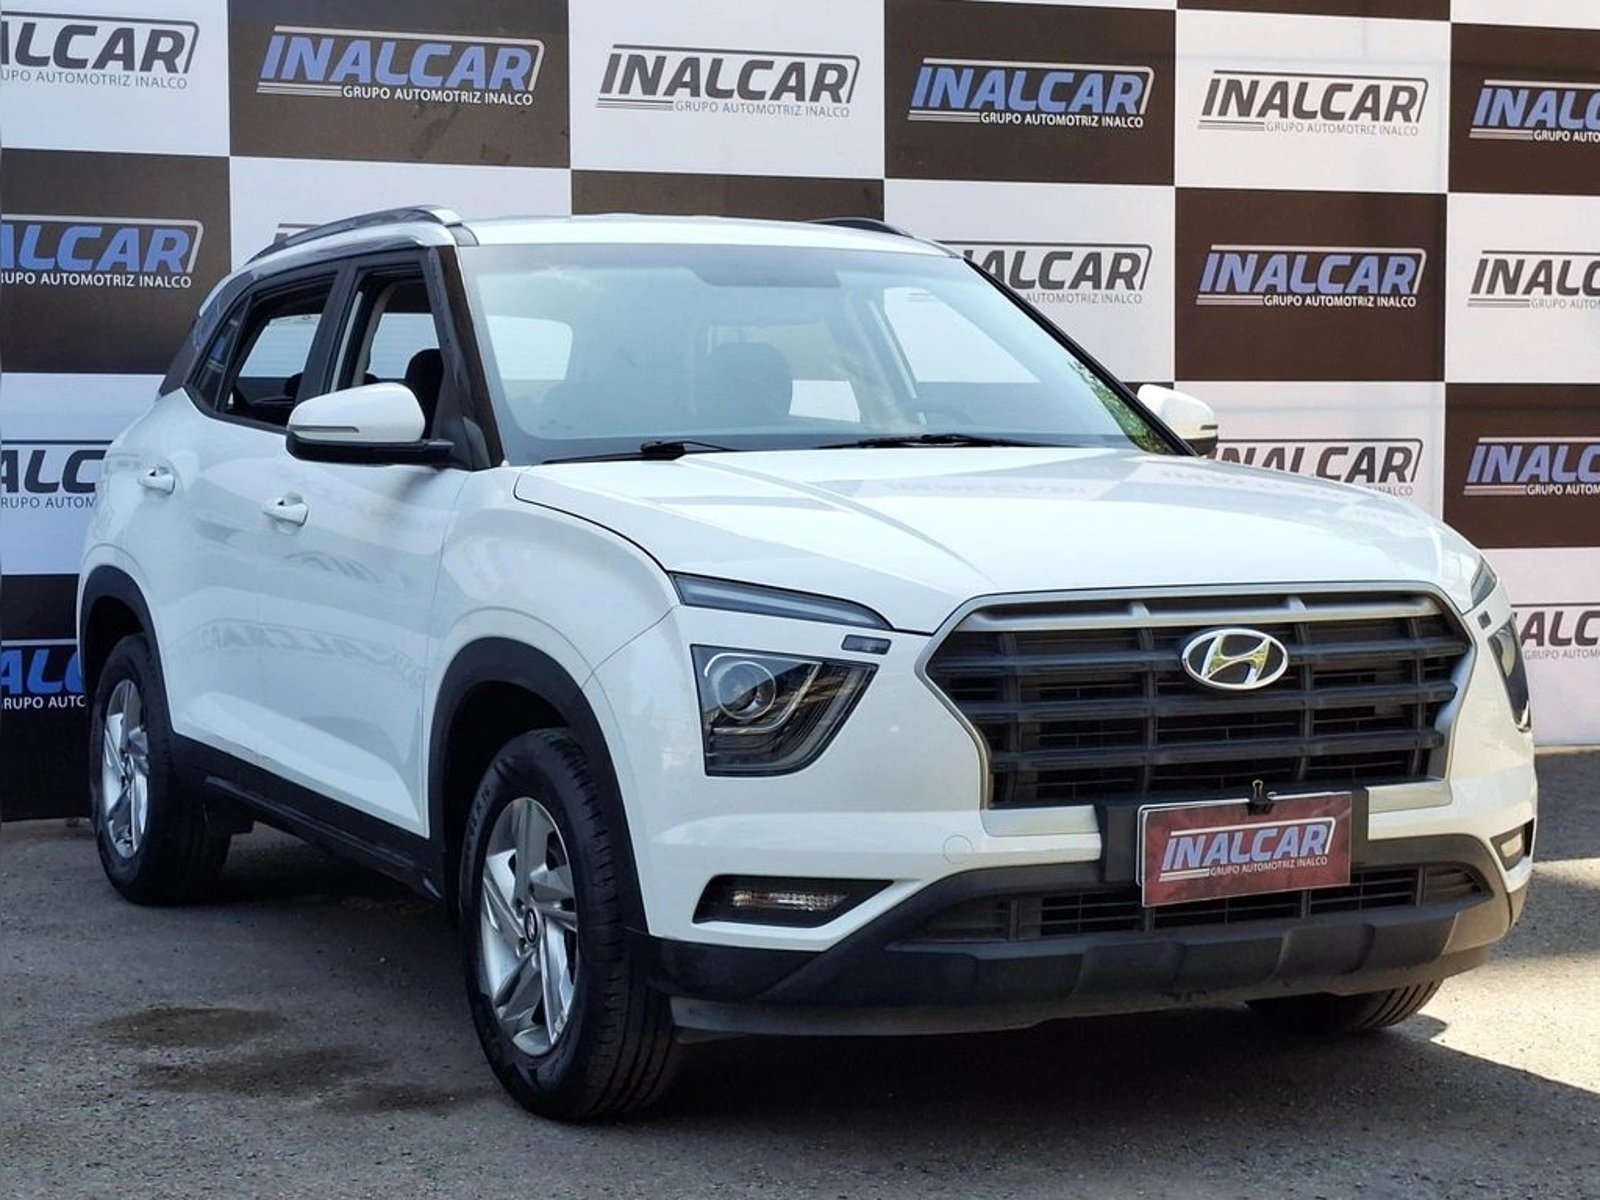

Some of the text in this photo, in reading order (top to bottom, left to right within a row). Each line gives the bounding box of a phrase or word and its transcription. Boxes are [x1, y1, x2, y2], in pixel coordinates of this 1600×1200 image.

[1, 21, 179, 74] LCAR
[260, 35, 533, 91] INALCAR
[35, 72, 132, 87] AUTOMOTRIZ
[135, 76, 188, 90] INALCO
[599, 52, 849, 104] INALCAR
[342, 85, 533, 106] GRUPO AUTOMOTRIZ INALCO
[910, 66, 1143, 114] INALCAR
[1201, 78, 1419, 123] INALCAR
[674, 101, 850, 118] GRUPO AUTOMOTRIZ INALCO
[980, 111, 1144, 129] GRUPO AUTOMOTRIZ INALCO
[1266, 121, 1419, 137] GRUPO AUTOMOTRIZ INALCO
[1533, 129, 1571, 141] GRUPO
[1, 224, 190, 273] LCAR
[40, 272, 136, 287] AUTOMOTRIZ
[138, 274, 192, 289] INALCO
[963, 249, 1142, 291] ALCAR
[1200, 253, 1417, 295] INALCAR
[1026, 292, 1143, 304] AUTOMOTRIZ INALCO
[1263, 295, 1417, 309] GRUPO AUTOMOTRIZ INALCO
[1569, 298, 1600, 309] AUTO
[1205, 446, 1413, 484] ACAR
[1527, 483, 1563, 495] GRUPO
[1513, 610, 1600, 647] ALC
[1161, 824, 1327, 871] INALCAR
[1210, 855, 1328, 877] GRUPO AUTOMOTRIZ INALCO
